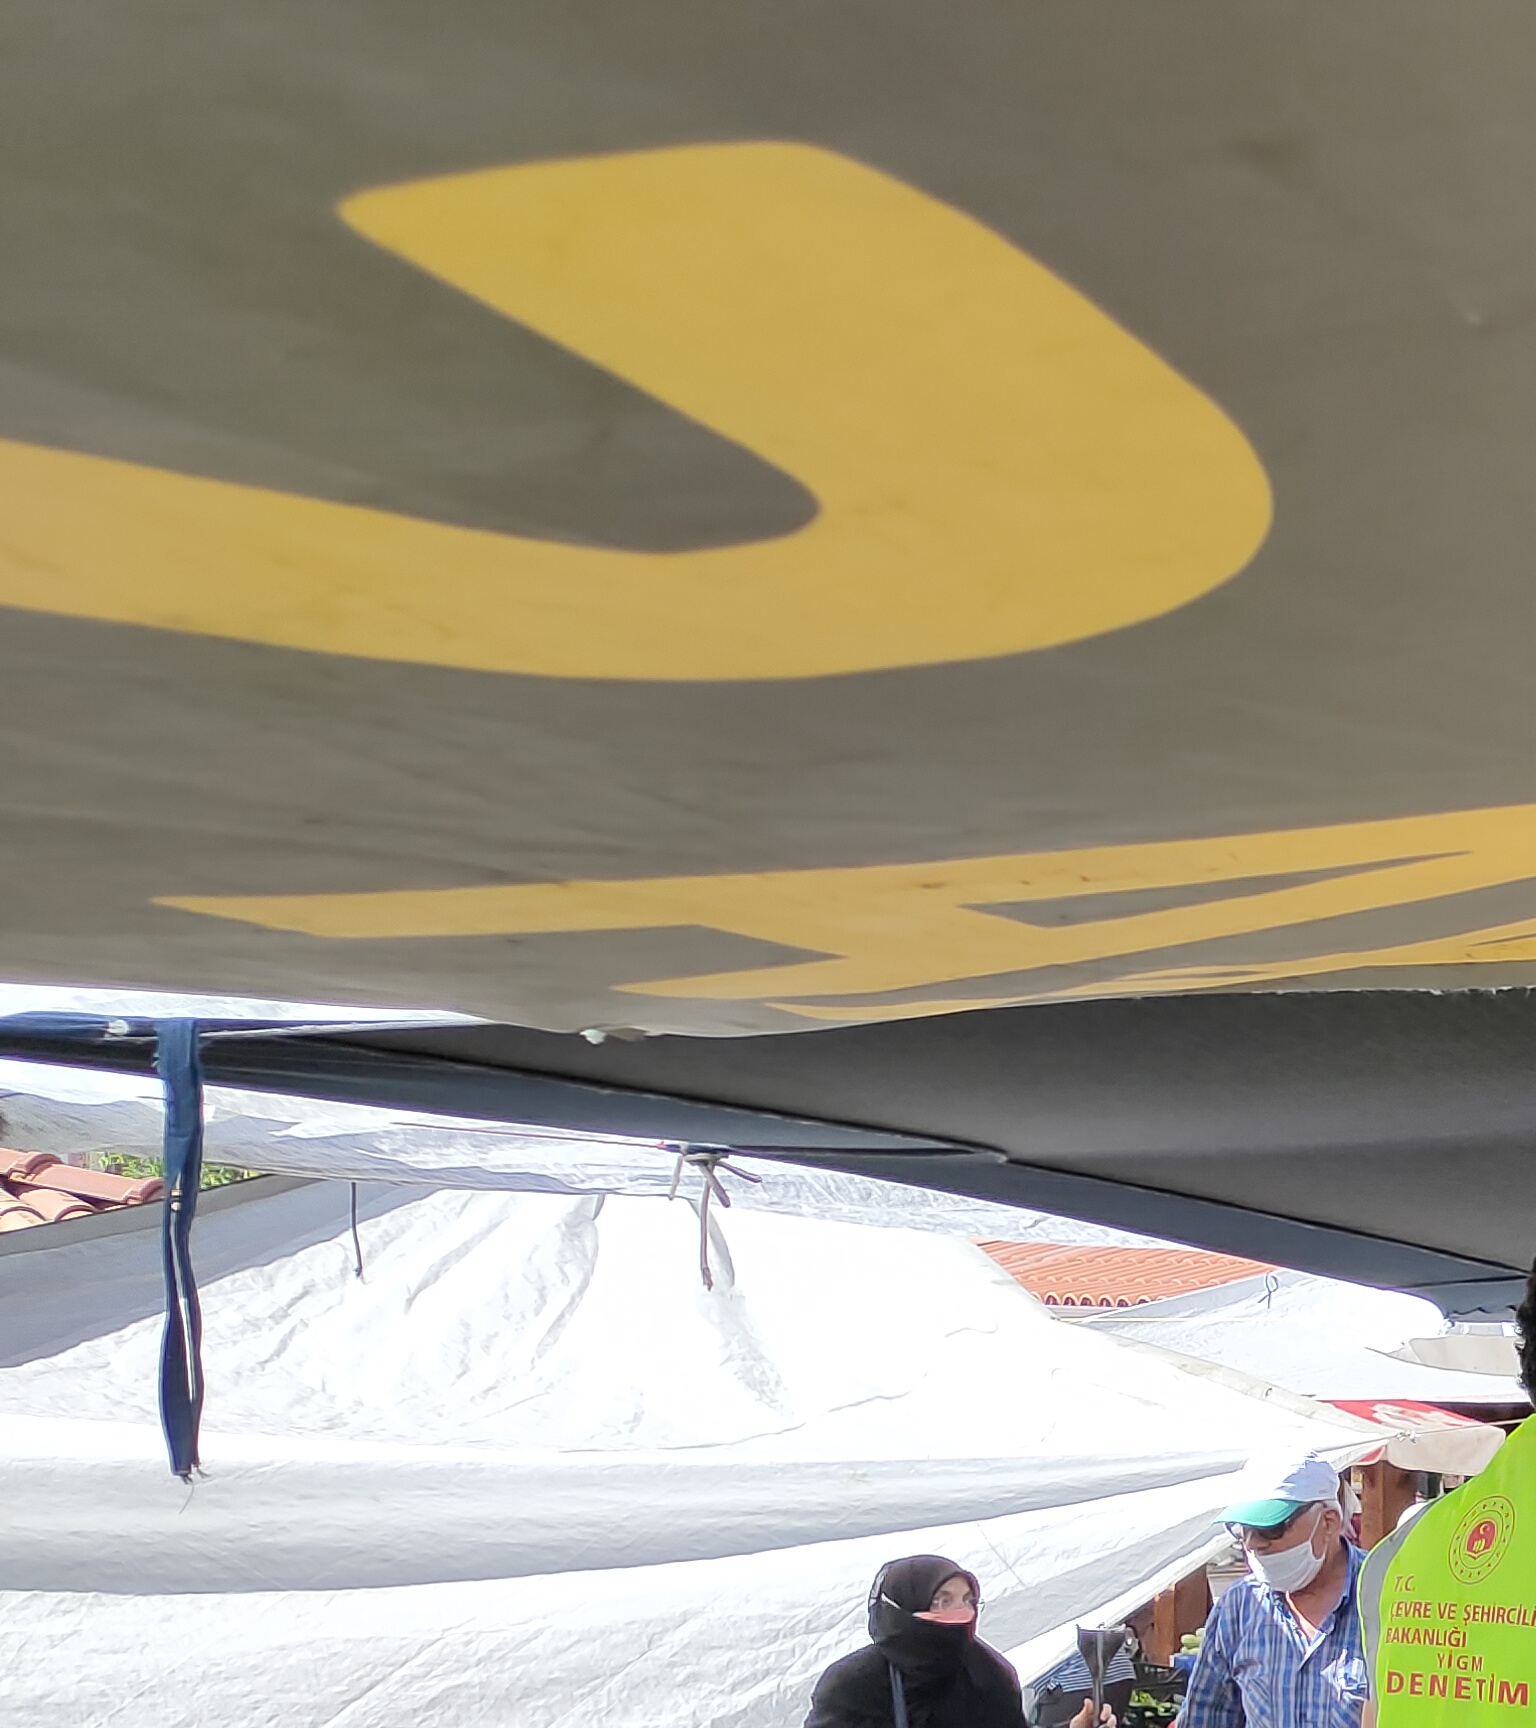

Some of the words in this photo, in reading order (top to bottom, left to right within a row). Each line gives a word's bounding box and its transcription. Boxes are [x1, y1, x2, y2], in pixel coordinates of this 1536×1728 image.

[1390, 1600, 1432, 1623] ÇEVRE
[1437, 1602, 1458, 1621] VE
[1385, 1626, 1467, 1648] BAKANLIĞI
[1437, 1650, 1483, 1673] YİGM
[1386, 1669, 1530, 1707] DENETİM
